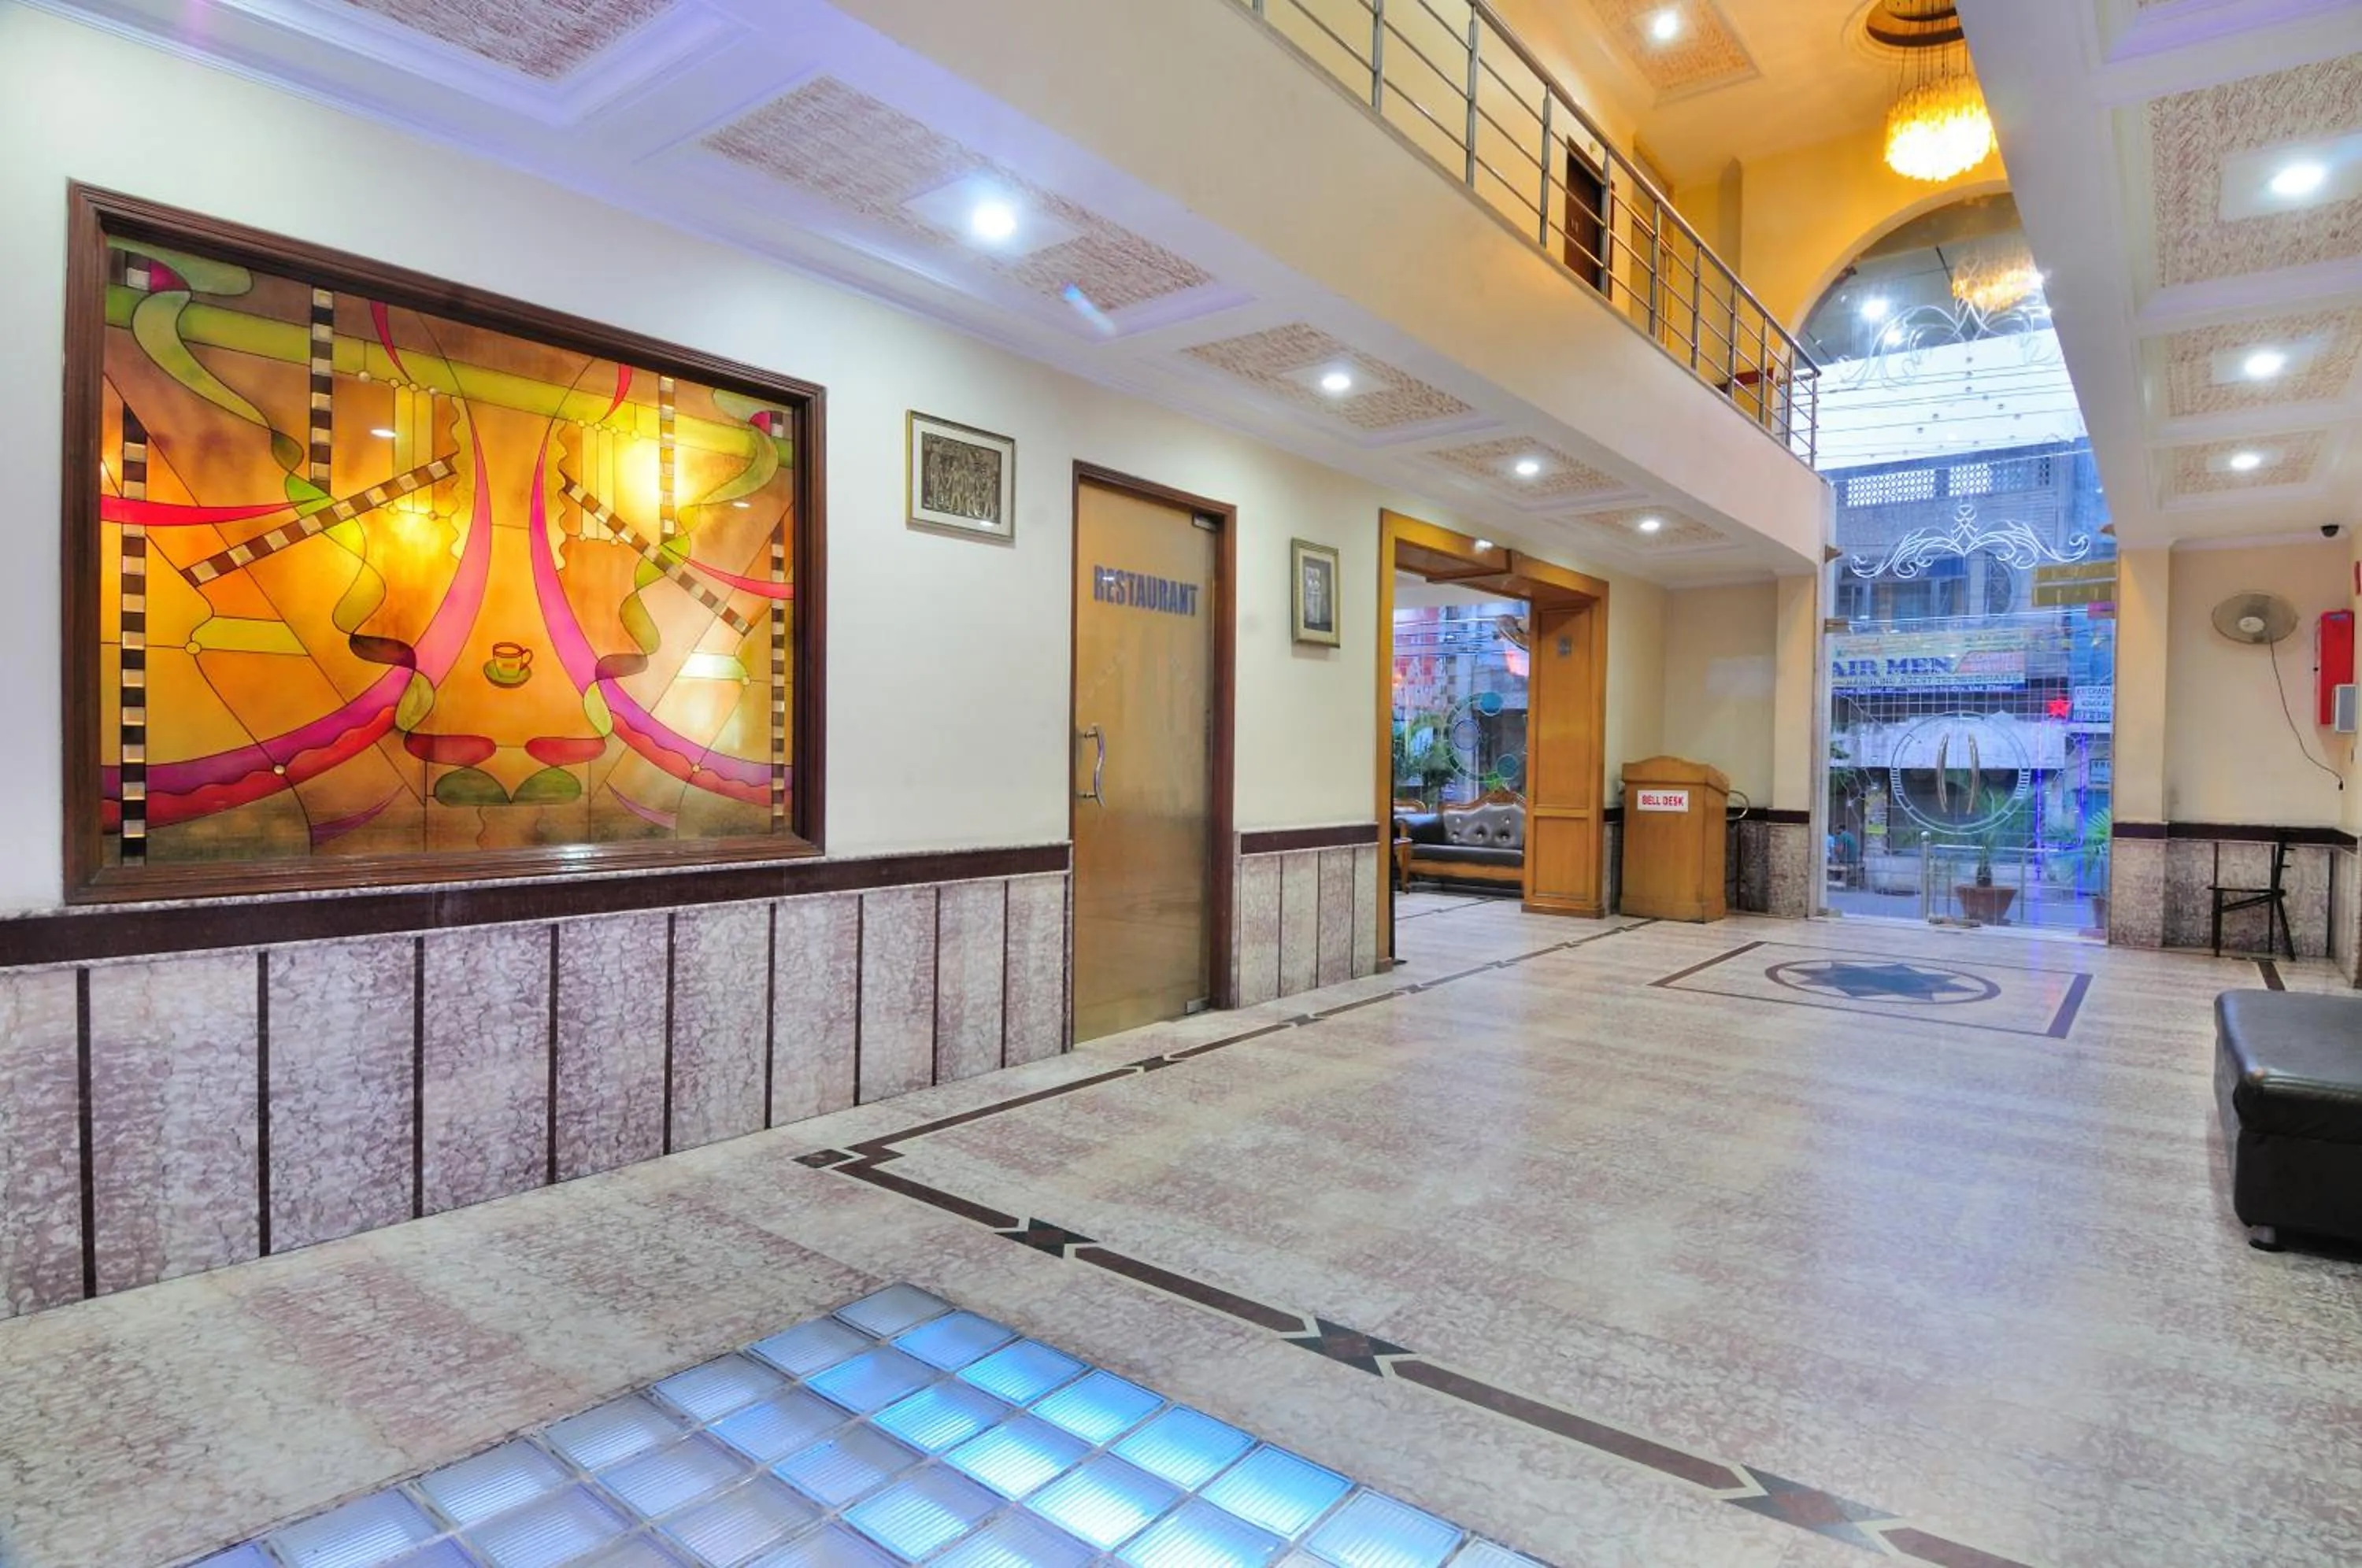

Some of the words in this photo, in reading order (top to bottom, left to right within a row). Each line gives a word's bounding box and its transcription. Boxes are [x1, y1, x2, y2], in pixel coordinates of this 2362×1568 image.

[1094, 564, 1198, 617] RESTAURANT
[1886, 656, 1951, 675] MEN
[1642, 794, 1660, 805] BELL
[1663, 796, 1683, 807] DESK
